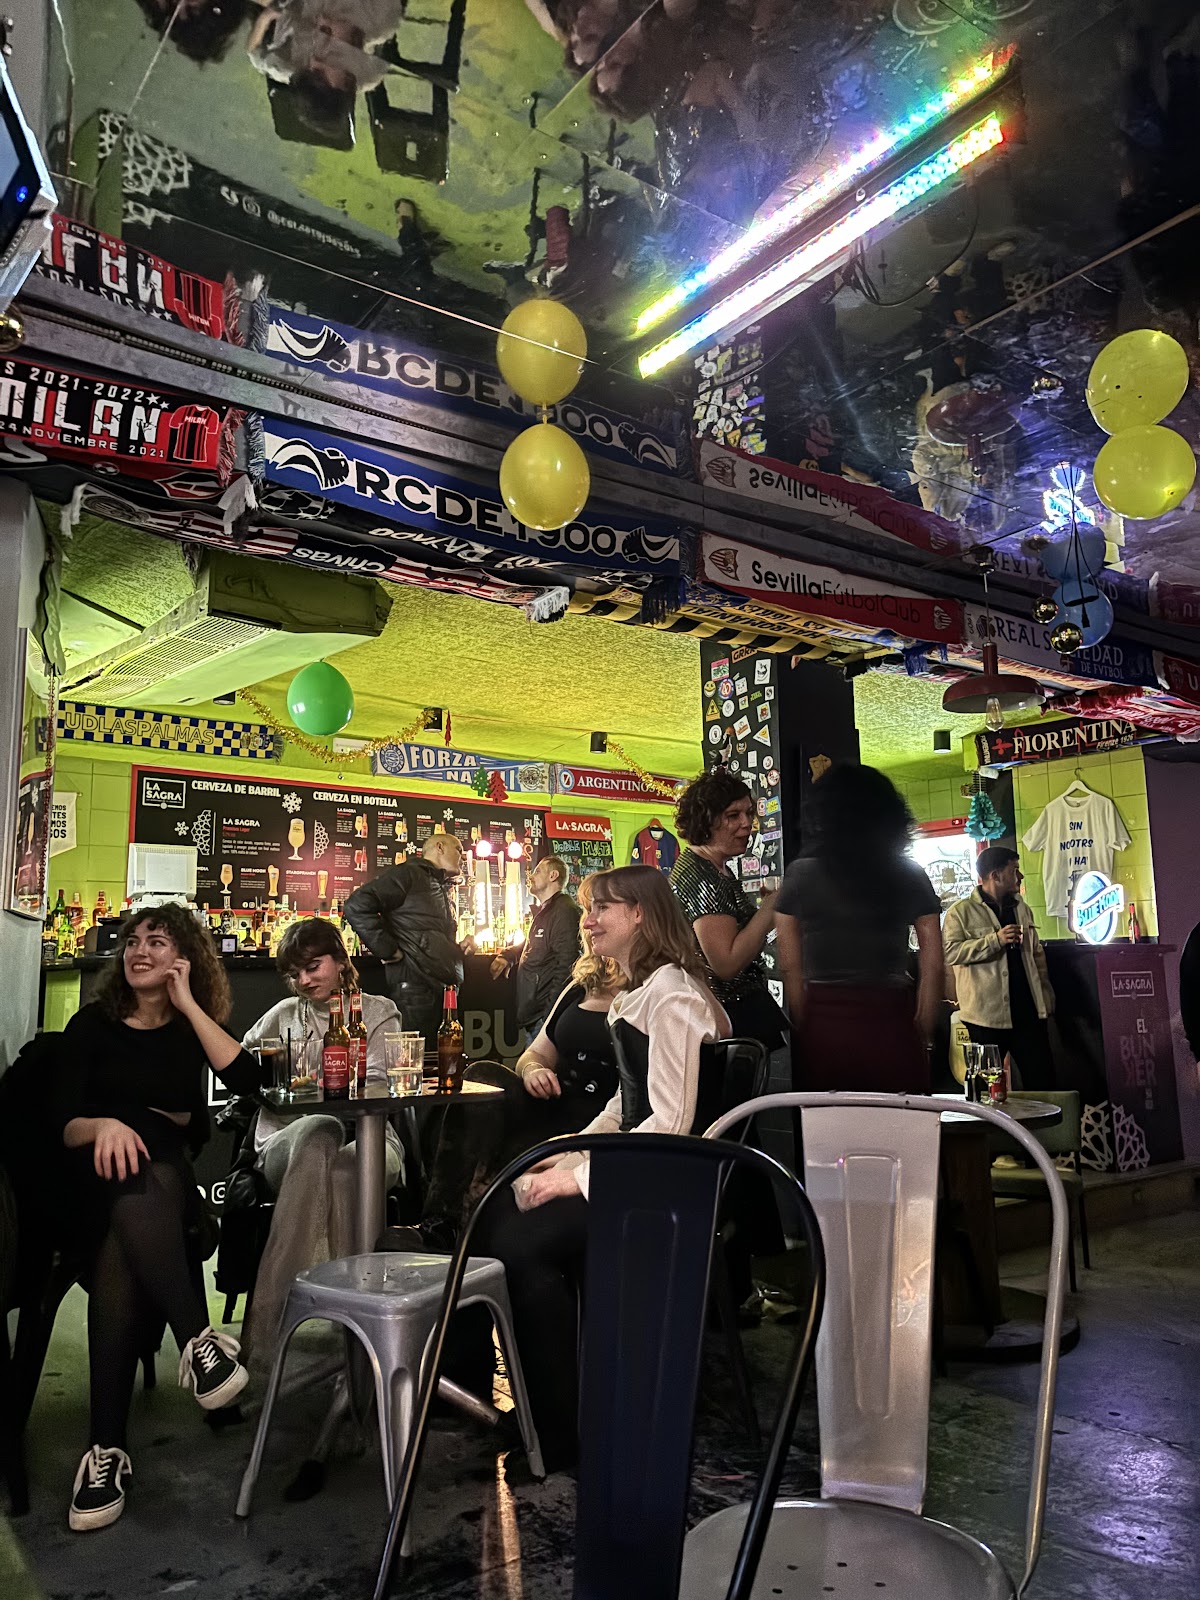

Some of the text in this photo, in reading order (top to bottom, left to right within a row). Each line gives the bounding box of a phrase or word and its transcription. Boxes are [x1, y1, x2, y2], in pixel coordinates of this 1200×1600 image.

[23, 426, 118, 450] NOVIEMBRE
[129, 445, 164, 458] 2021
[995, 616, 1041, 648] REAL
[1013, 719, 1138, 754] FIORENTINA
[410, 746, 478, 768] FORZA
[146, 781, 160, 791] LA
[192, 779, 281, 797] CERVEZA DE BARRIL
[146, 790, 182, 801] SAGRA
[313, 791, 398, 807] CERVEZA EN BOTELLA
[234, 819, 260, 827] SAGRA
[524, 819, 542, 828] BUN
[1069, 821, 1083, 830] SIN
[1136, 1018, 1148, 1034] EL
